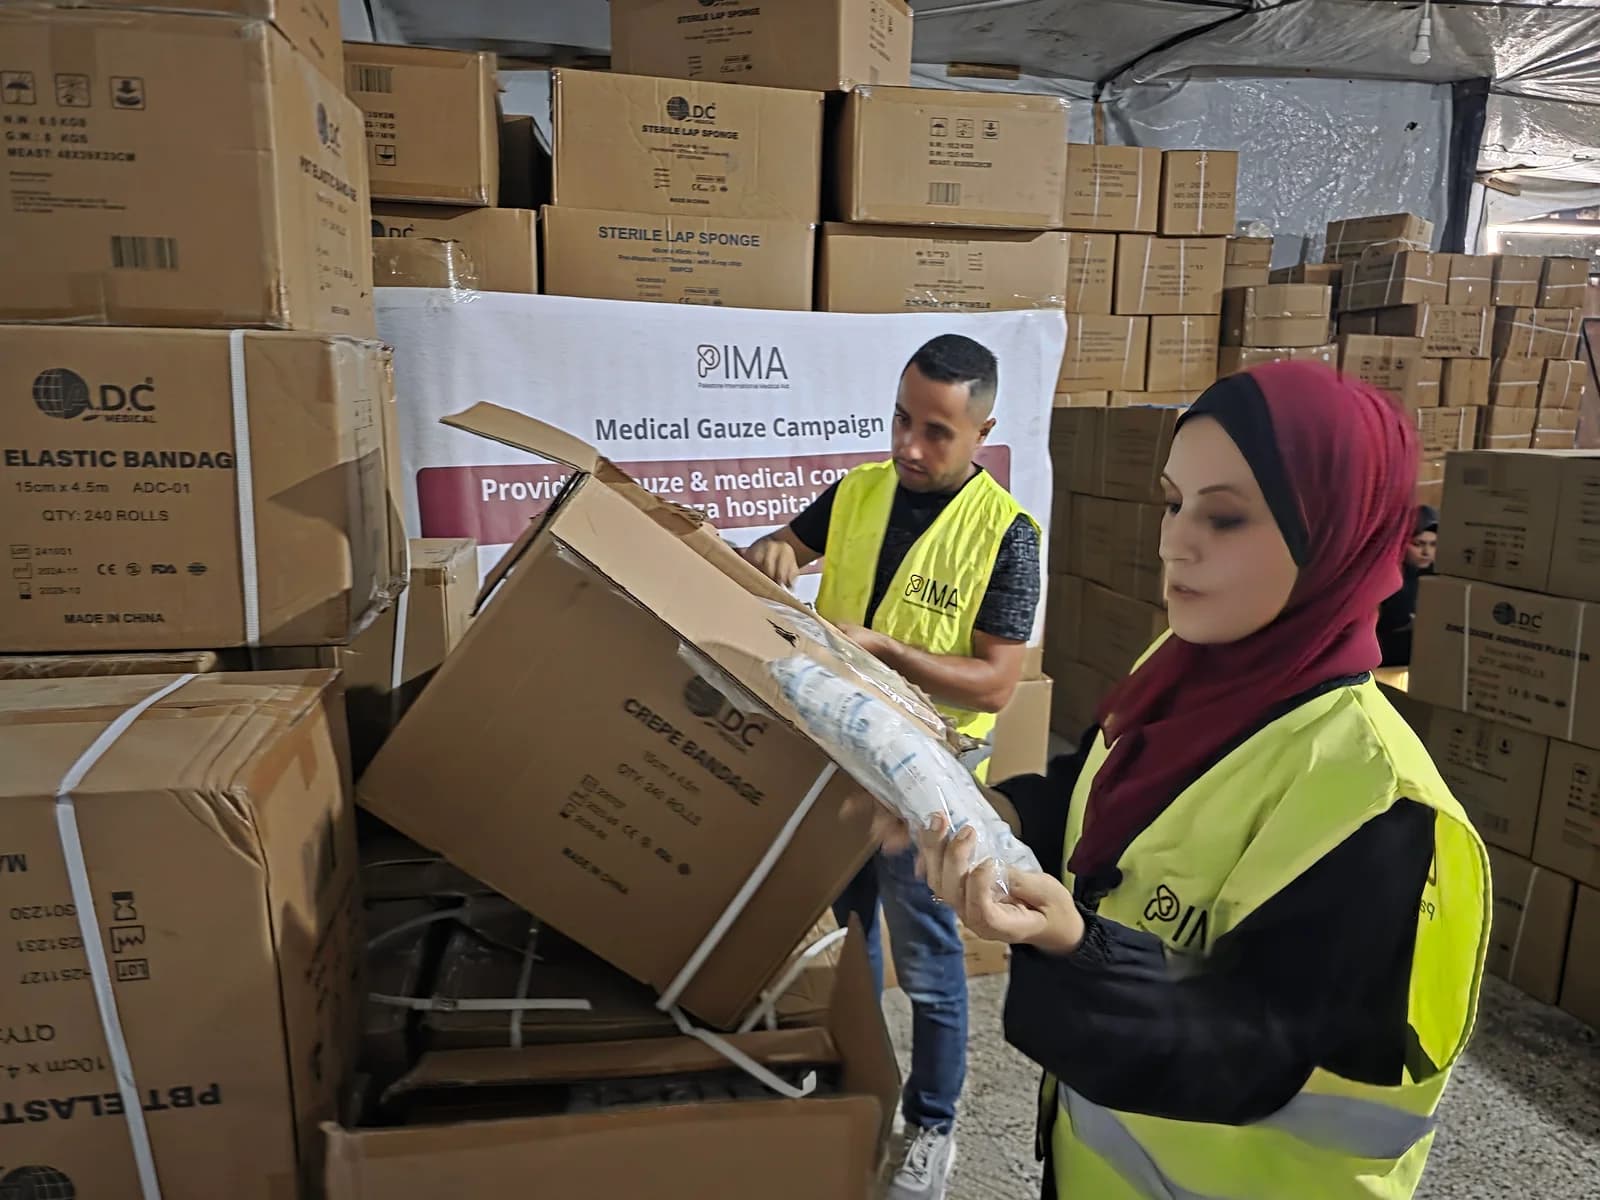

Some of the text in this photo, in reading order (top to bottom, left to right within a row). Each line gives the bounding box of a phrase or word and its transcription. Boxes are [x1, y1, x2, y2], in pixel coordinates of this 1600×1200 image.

[642, 125, 739, 140] STERILE LAP SPONGE
[598, 226, 760, 247] STERILE LAP SPONGE
[697, 344, 788, 379] PIMA
[595, 415, 885, 440] Medical Gauze Campaign
[5, 449, 237, 469] ELASTIC BANDAG
[15, 482, 190, 494] 15cm x 4.5m ADC-01
[481, 475, 571, 501] Provid
[690, 471, 708, 492] &
[715, 466, 804, 490] medical
[810, 468, 850, 486] con
[42, 509, 169, 522] QTY: 240 ROLLS
[727, 492, 816, 520] hospital
[905, 574, 959, 612] PIMA
[64, 613, 165, 624] MADE IN CHINA
[623, 698, 683, 747] CREPE
[682, 739, 765, 806] BANDAGE
[120, 964, 146, 977] LOT
[28, 1062, 40, 1074] x
[48, 1057, 105, 1073] 10cm
[0, 1083, 222, 1125] PBT ELAST
